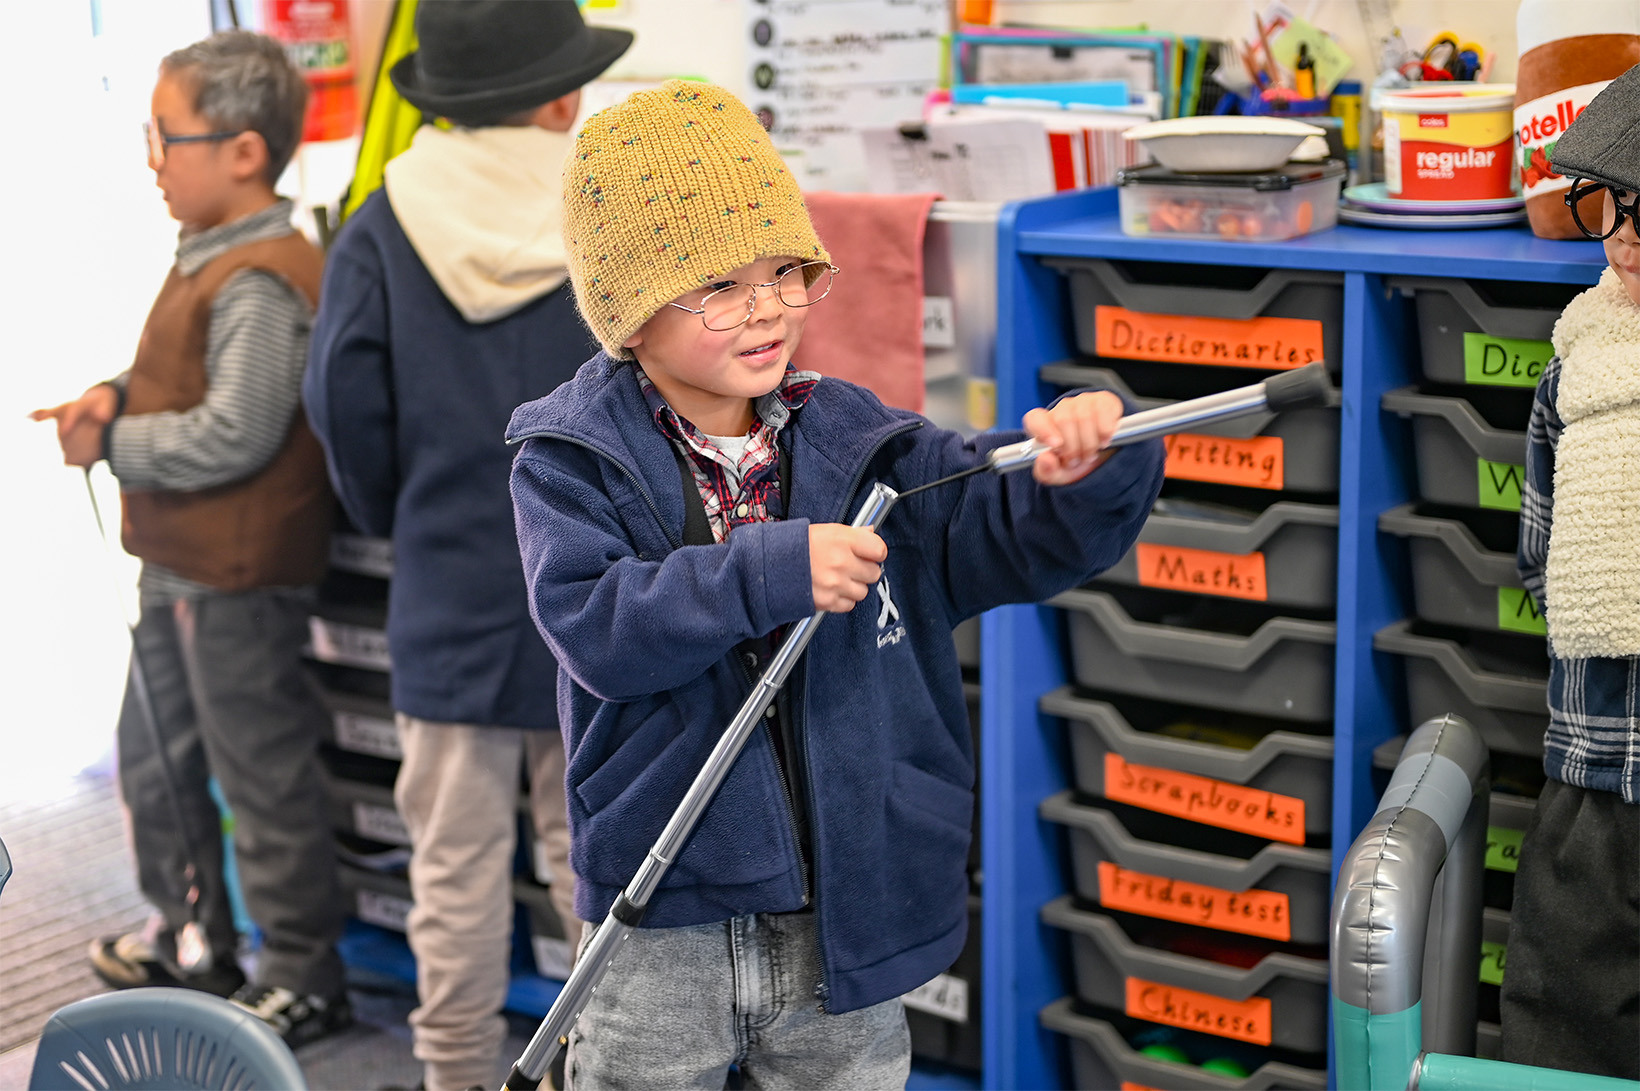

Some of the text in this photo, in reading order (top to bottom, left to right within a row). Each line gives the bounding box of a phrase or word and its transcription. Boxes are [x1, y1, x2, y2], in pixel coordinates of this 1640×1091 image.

[1514, 99, 1588, 147] otell
[1416, 147, 1496, 171] regular
[1110, 319, 1316, 363] Dictionaries
[1482, 343, 1548, 378] Dic
[1168, 436, 1275, 481] riting
[1155, 552, 1255, 590] Maths
[1119, 762, 1295, 827] Scrapbooks
[1112, 865, 1285, 924] Friday test
[1139, 986, 1258, 1035] Chinese
